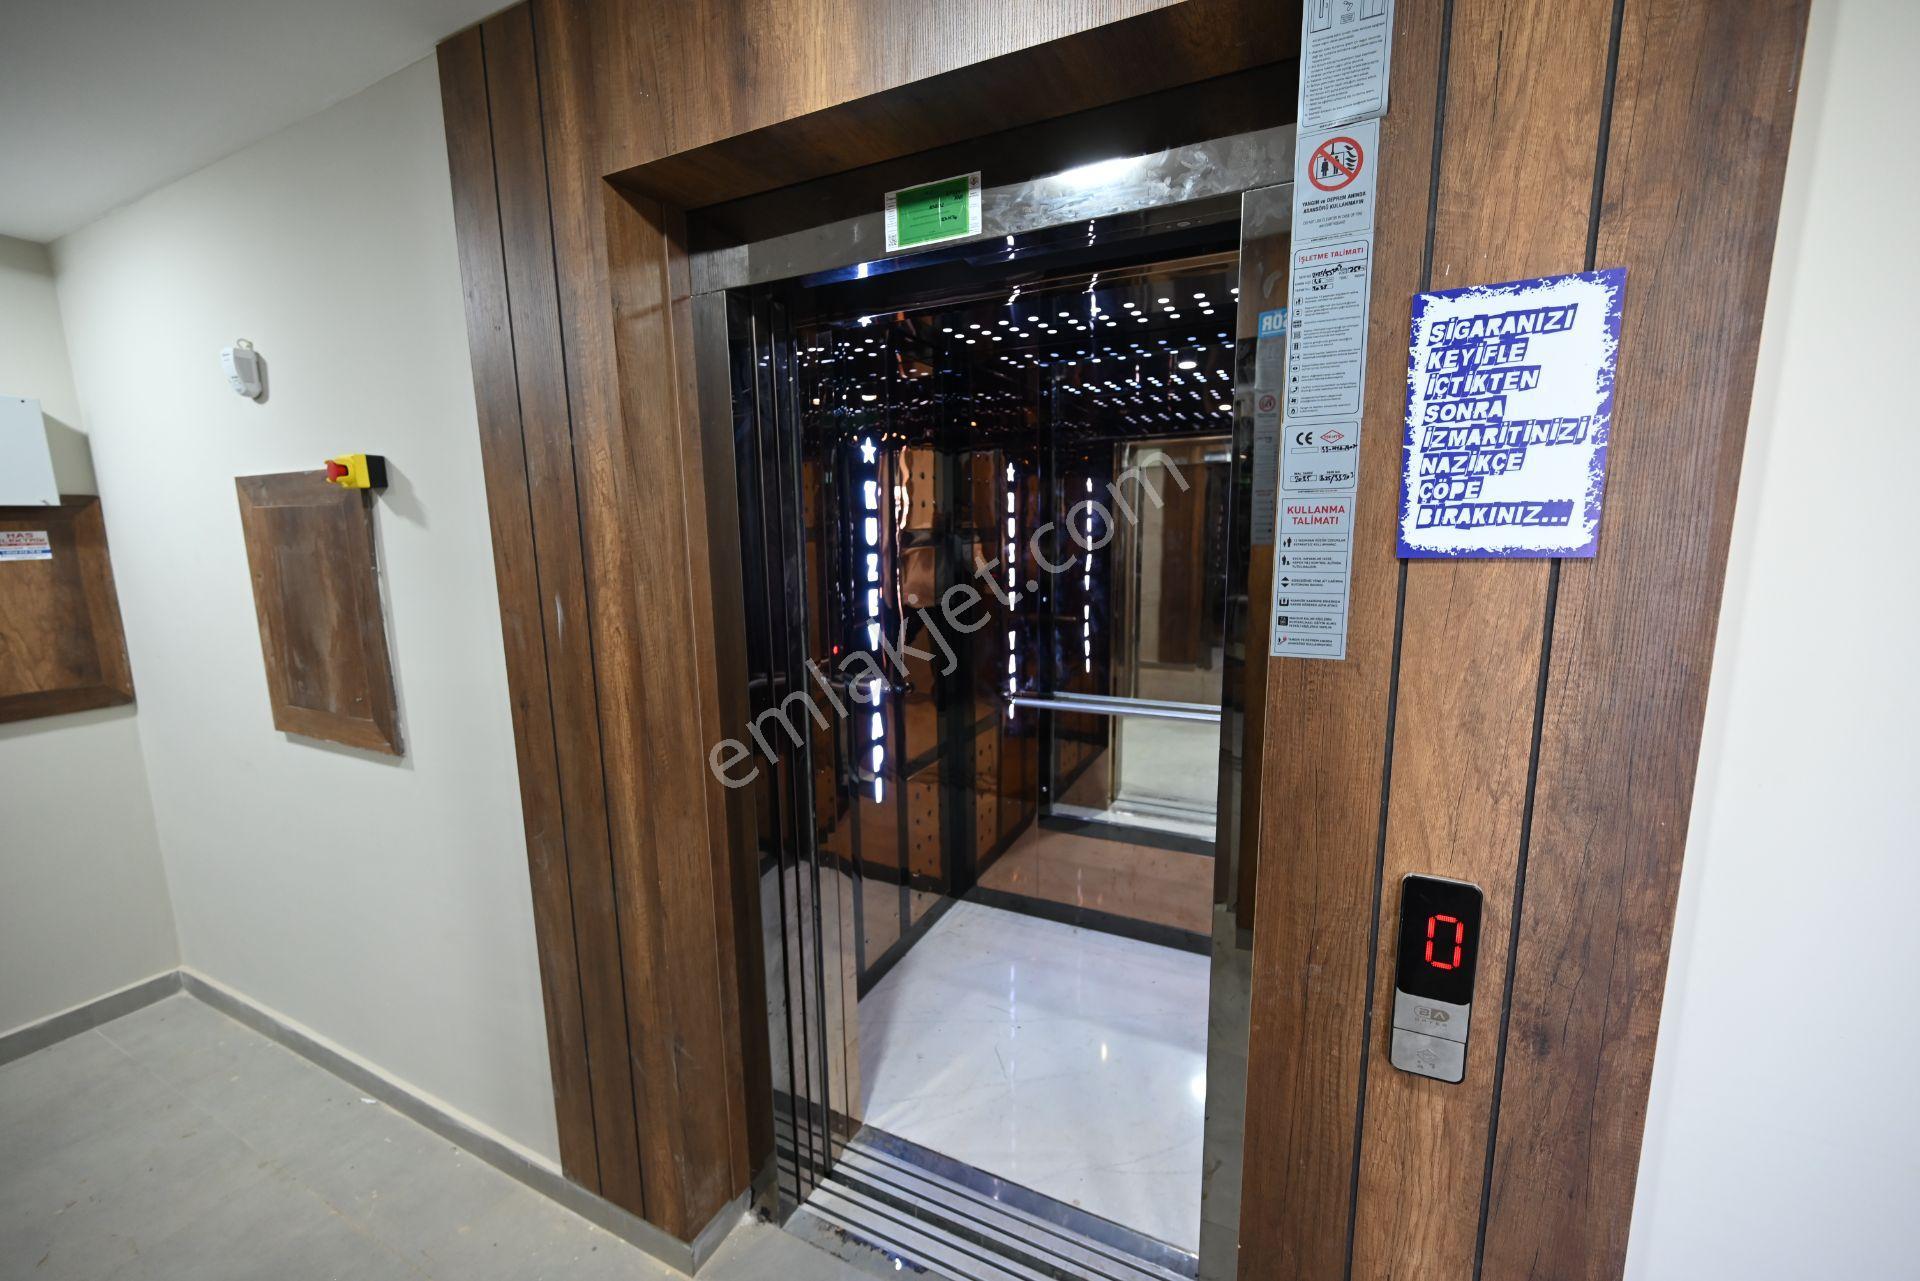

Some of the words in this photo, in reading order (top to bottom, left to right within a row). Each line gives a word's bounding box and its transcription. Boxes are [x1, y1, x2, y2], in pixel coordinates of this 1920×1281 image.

[1298, 253, 1329, 264] İŞLETME
[1331, 247, 1364, 258] TALİMATI
[1428, 304, 1578, 346] SİGARANIZI
[1425, 337, 1529, 373] KEYİFLE
[1424, 365, 1541, 400] İÇTİKTEN
[1422, 395, 1507, 426] SONRA
[1420, 416, 1592, 452] İZMARİTİNİZİ
[1419, 448, 1527, 477] NAZİKÇE
[1417, 476, 1484, 504] ÇÖPE
[1287, 505, 1345, 514] KULLANMA
[1292, 515, 1339, 525] TALİMATI
[1416, 501, 1574, 529] BIRAKINIZ...
[1425, 914, 1464, 970] 0
